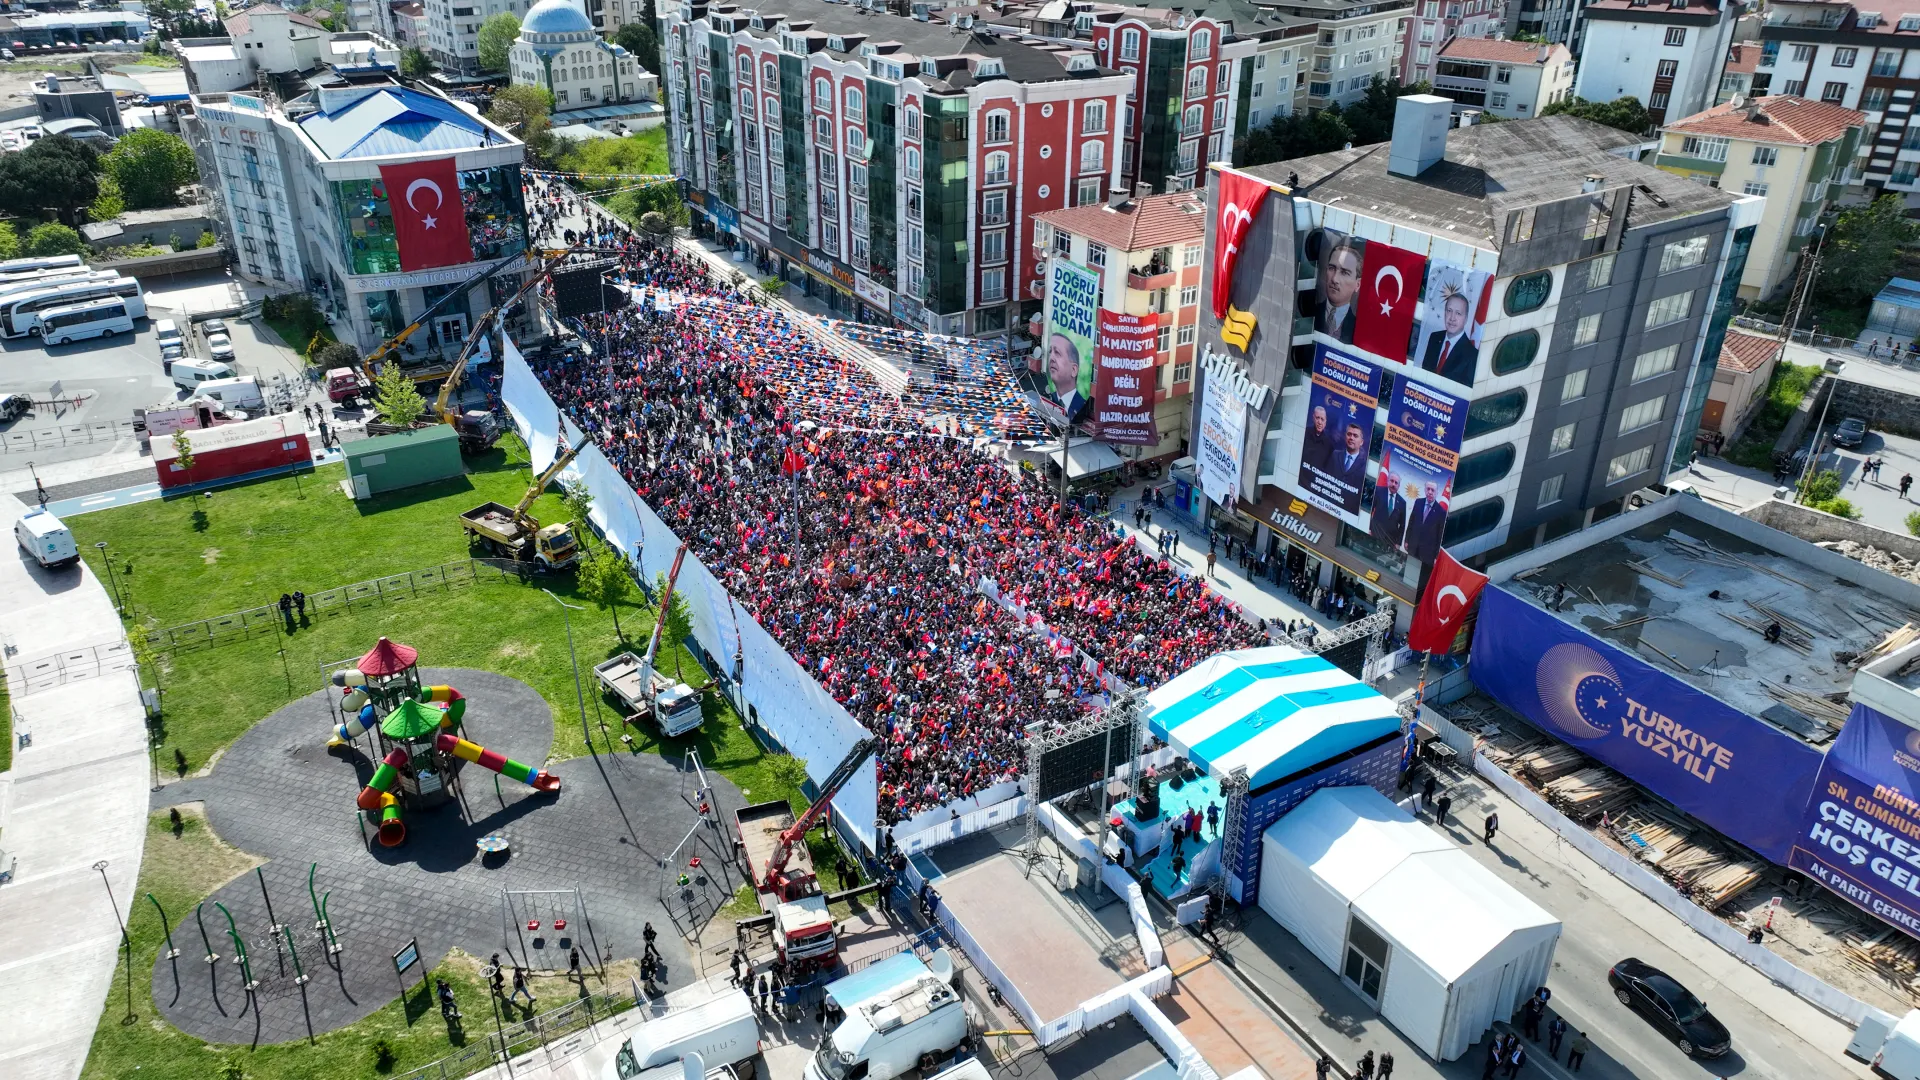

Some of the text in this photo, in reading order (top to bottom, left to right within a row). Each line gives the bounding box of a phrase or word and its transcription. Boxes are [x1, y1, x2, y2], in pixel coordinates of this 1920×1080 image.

[232, 96, 259, 109] SIEMENS
[808, 252, 855, 287] mondihome
[1055, 267, 1096, 296] DOĞRU
[1053, 281, 1094, 309] ZAMAN
[1052, 295, 1093, 324] DOĞRU
[1118, 315, 1139, 324] SAYIN
[1051, 309, 1092, 339] ADAM
[1102, 335, 1110, 348] 14
[1200, 342, 1269, 411] istikbal
[1322, 366, 1369, 393] DOĞRU ADAM
[1323, 357, 1346, 373] DOĞRU
[1345, 367, 1370, 383] ZAMAN
[1108, 393, 1143, 408] KÖFTELER
[1403, 396, 1451, 424] DOĞRU ADAM
[1404, 388, 1453, 415] DOĞRU ZAMAN
[1100, 411, 1151, 424] HAZIR OLACAK
[192, 429, 268, 449] SAĞLIK BAKANLIĞI
[220, 429, 237, 437] T.C.
[1203, 421, 1238, 461] ERDOĞAN
[1270, 507, 1323, 544] istikbal
[1827, 781, 1850, 804] SN.
[1809, 822, 1869, 866] HOŞ
[1810, 862, 1827, 882] AK
[1829, 873, 1872, 905] PARTİ
